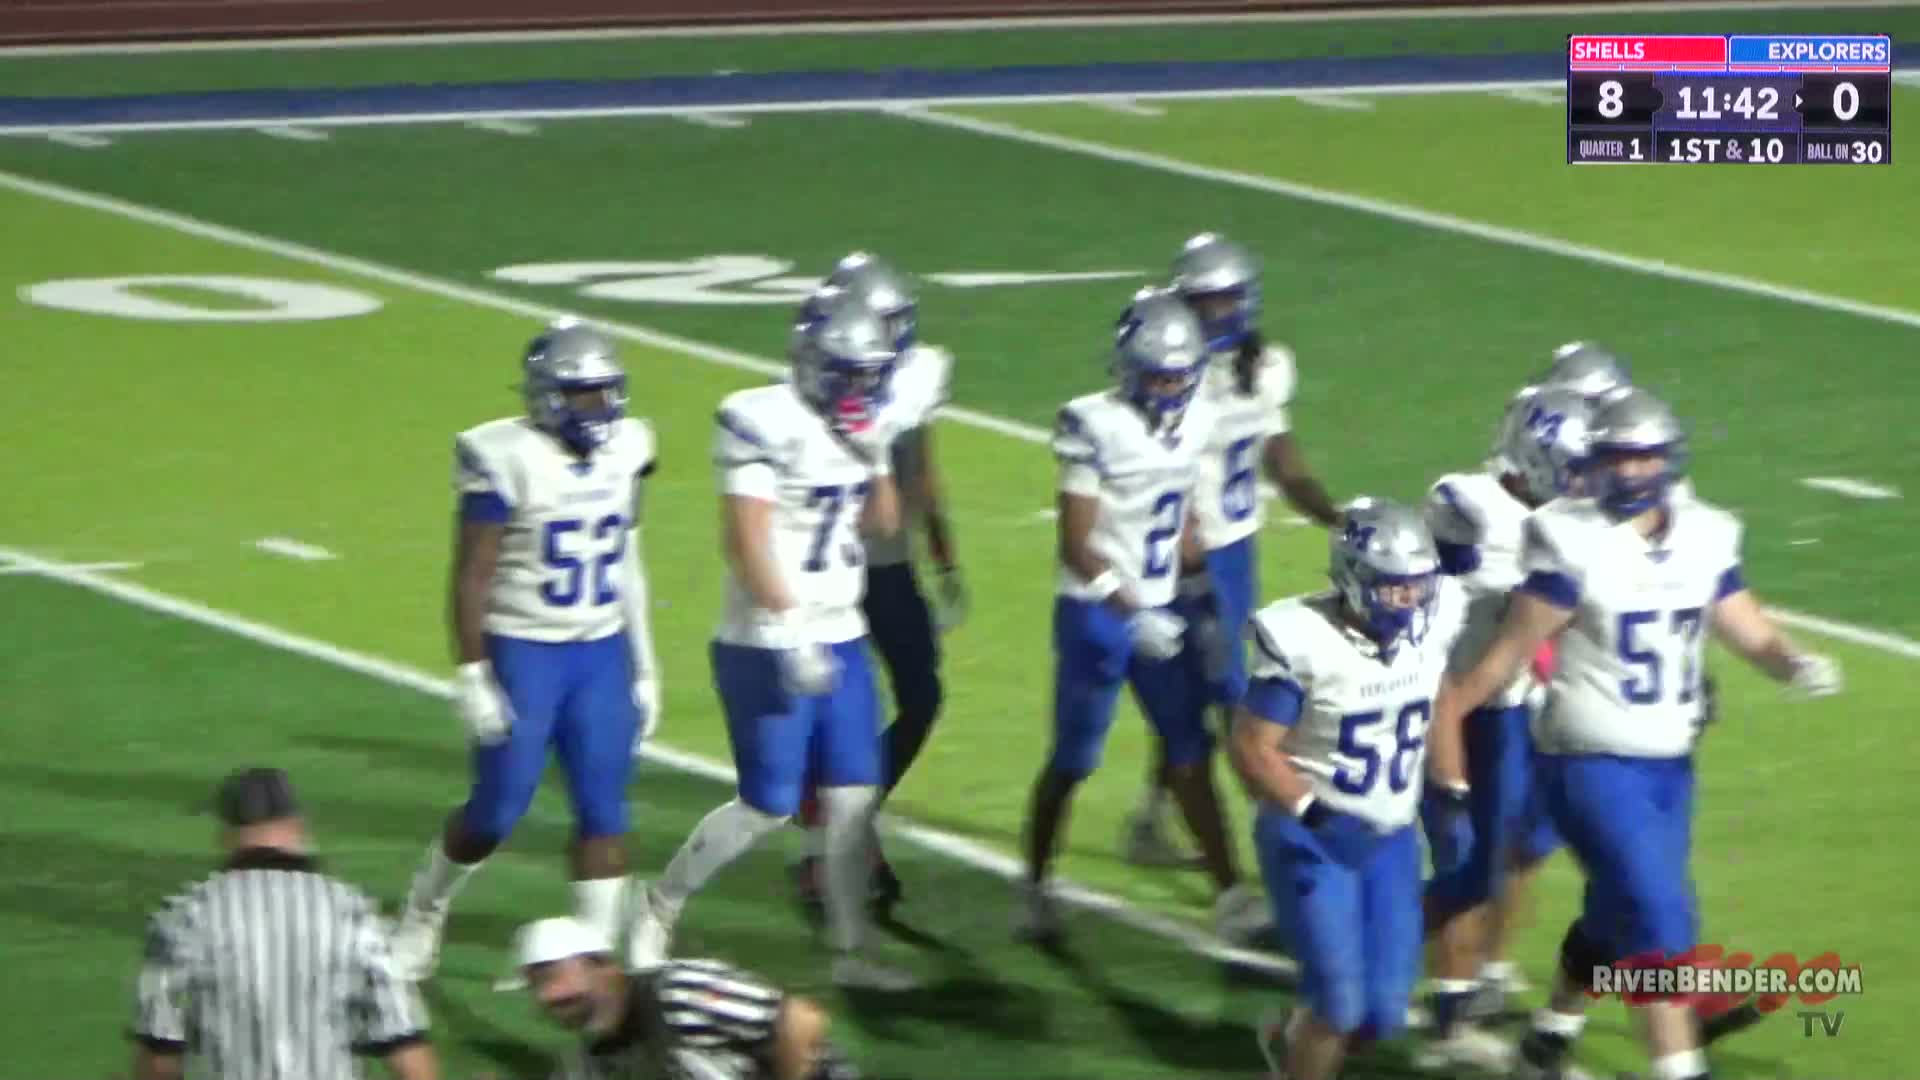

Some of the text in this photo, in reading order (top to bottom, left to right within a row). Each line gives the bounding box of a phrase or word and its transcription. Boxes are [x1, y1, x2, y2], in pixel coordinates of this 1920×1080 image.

[541, 514, 626, 606] 52
[1141, 491, 1184, 579] 2
[1617, 607, 1704, 705] 57
